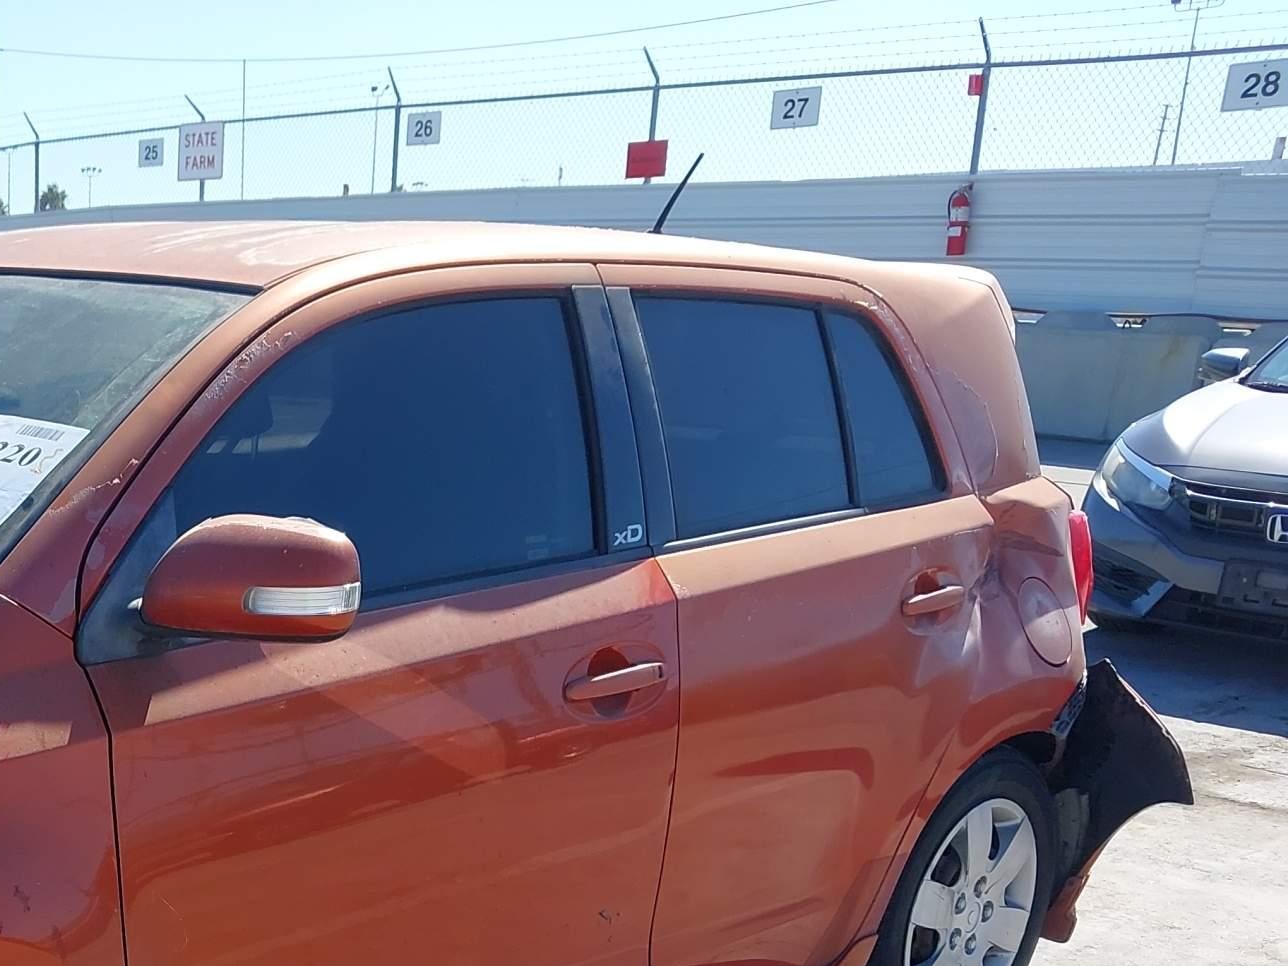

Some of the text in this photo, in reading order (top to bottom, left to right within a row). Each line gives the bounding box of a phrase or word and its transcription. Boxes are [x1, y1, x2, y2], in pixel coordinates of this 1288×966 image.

[1240, 71, 1281, 99] 28
[782, 97, 810, 120] 27
[414, 119, 433, 138] 26
[184, 131, 217, 148] STATE
[144, 145, 159, 161] 25
[184, 154, 216, 170] FARM
[613, 523, 643, 546] xD
